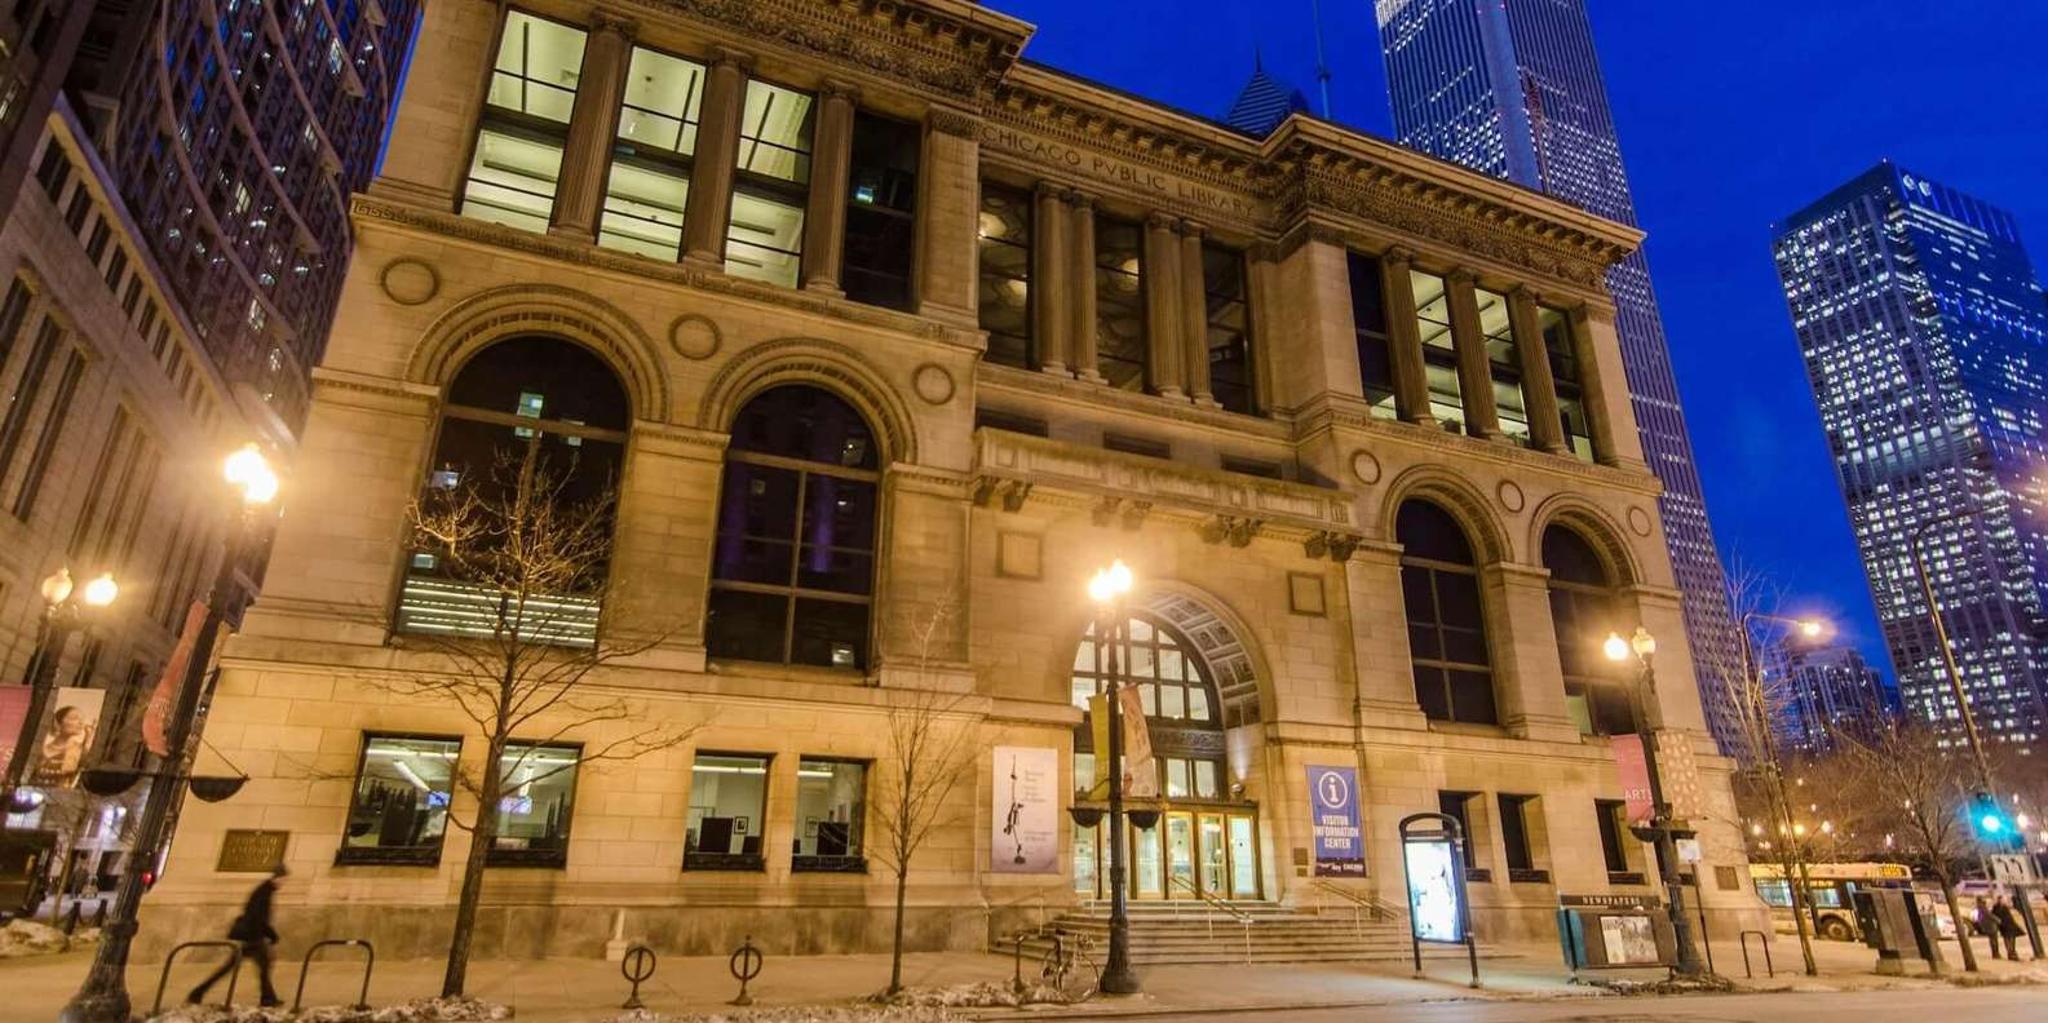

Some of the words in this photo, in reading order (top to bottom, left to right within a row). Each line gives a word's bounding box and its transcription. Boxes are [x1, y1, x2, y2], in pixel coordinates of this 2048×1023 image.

[982, 126, 1081, 166] CHICAGO
[1092, 157, 1167, 192] PVBLIC
[1324, 838, 1351, 849] CENTER
